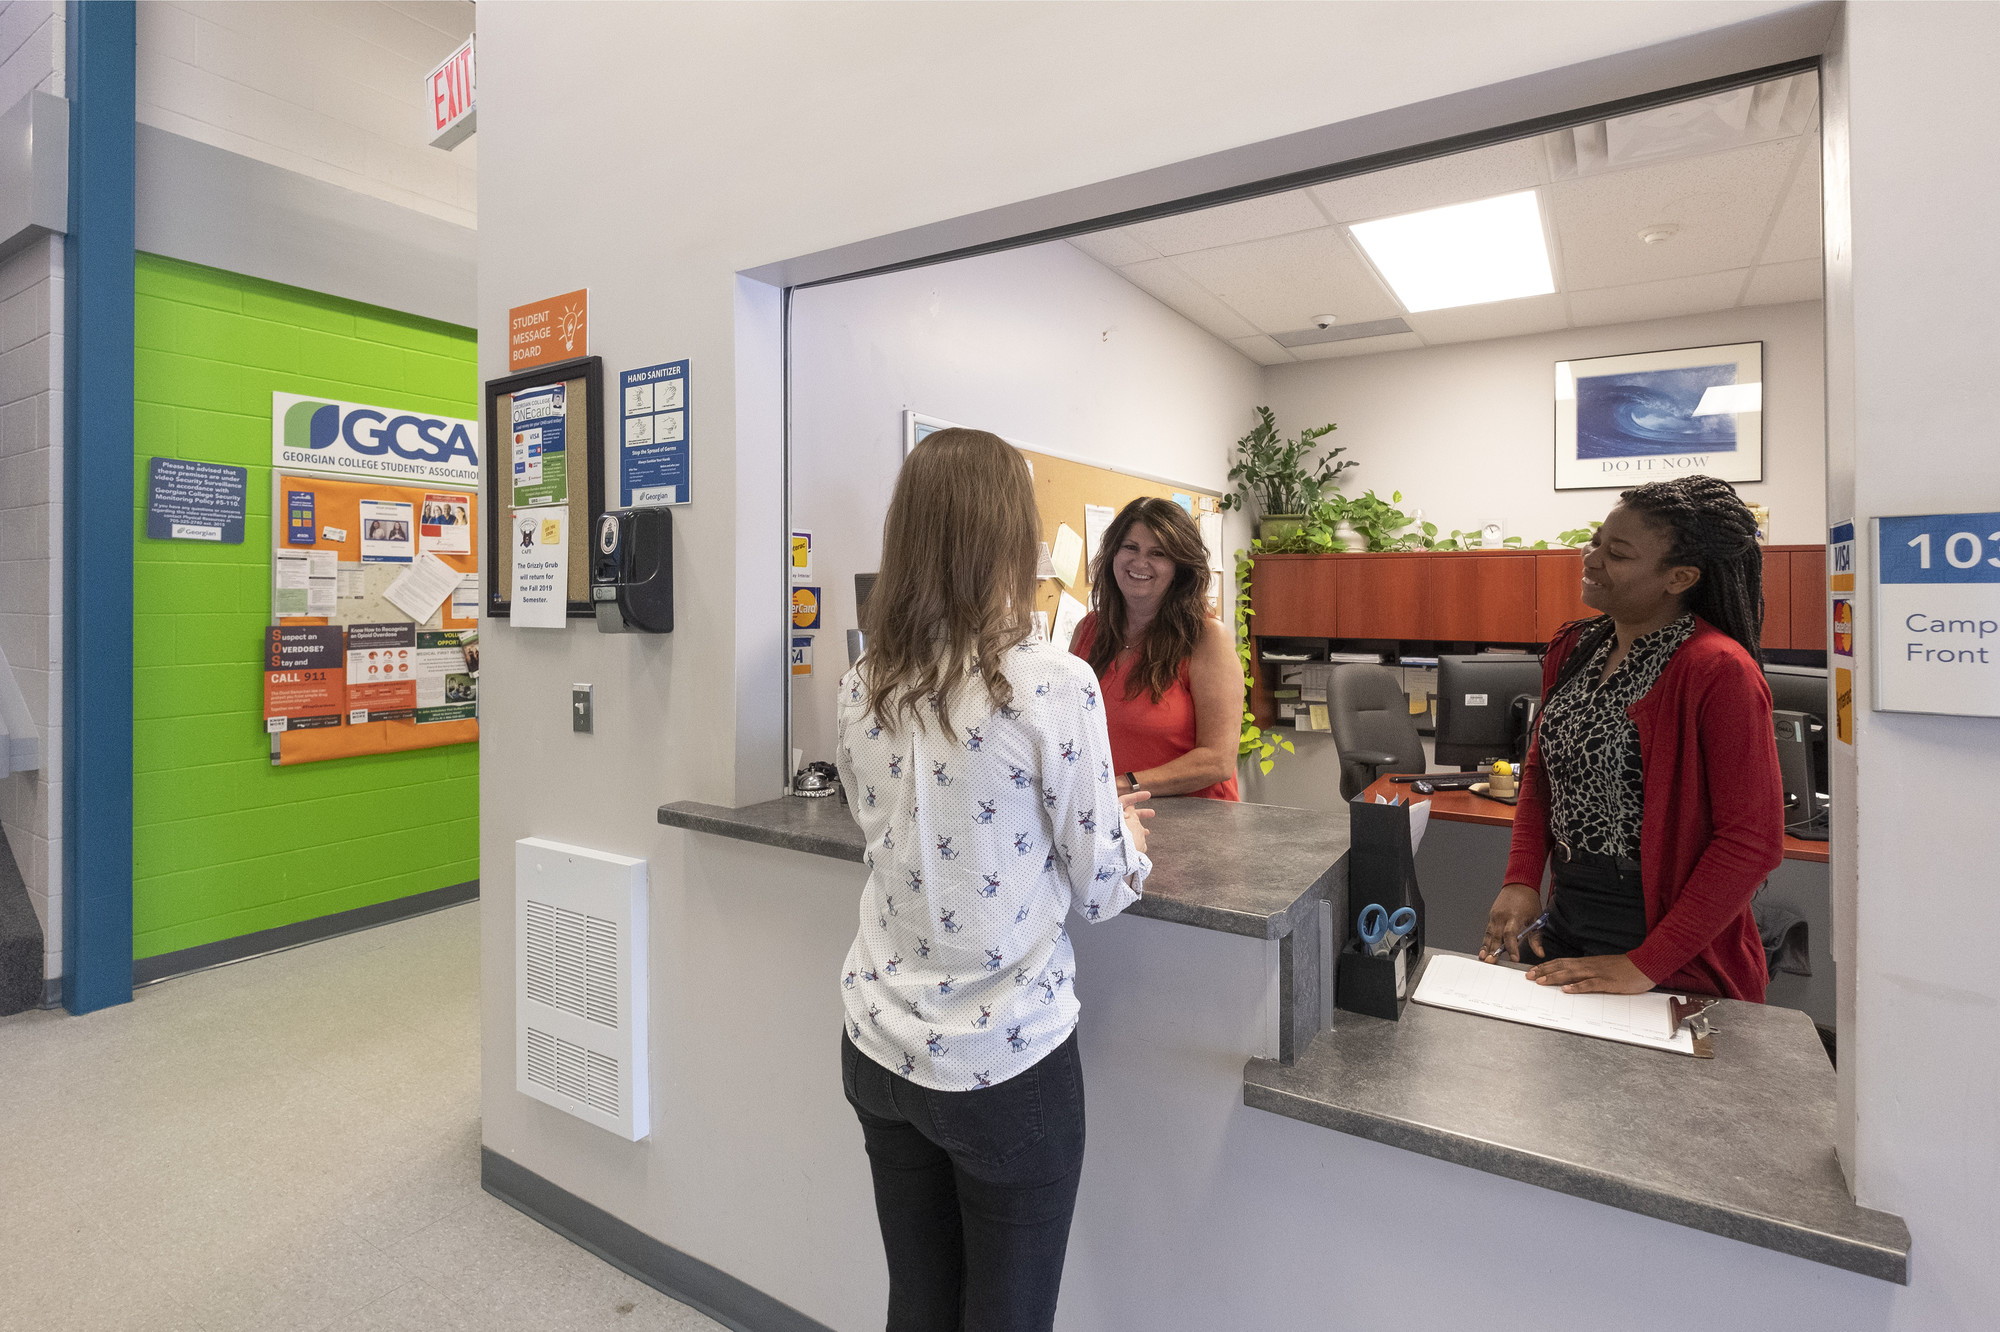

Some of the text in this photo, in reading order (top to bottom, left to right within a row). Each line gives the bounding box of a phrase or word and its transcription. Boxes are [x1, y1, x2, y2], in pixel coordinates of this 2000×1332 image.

[434, 46, 471, 130] EXIT
[513, 311, 550, 330] STUDENT
[513, 327, 551, 345] MESSAGE
[513, 345, 541, 360] BOARD
[627, 365, 681, 383] HAND SANITIZER
[513, 403, 551, 422] ONEcard
[342, 409, 478, 466] GCSA
[283, 451, 335, 466] GEORGIAN
[338, 457, 379, 470] COLLEGE
[381, 462, 427, 475] STUDENTS'
[1602, 456, 1709, 472] DO IT NOW
[176, 476, 202, 485] Security
[204, 479, 242, 488] Surveillance
[155, 487, 241, 501] Georgian College Security
[156, 494, 193, 503] Monitoring
[646, 492, 668, 501] Georgian
[1834, 544, 1850, 572] VISA
[1906, 613, 1998, 639] Camp
[1907, 643, 1989, 664] Front
[271, 672, 326, 683] CALL 911
